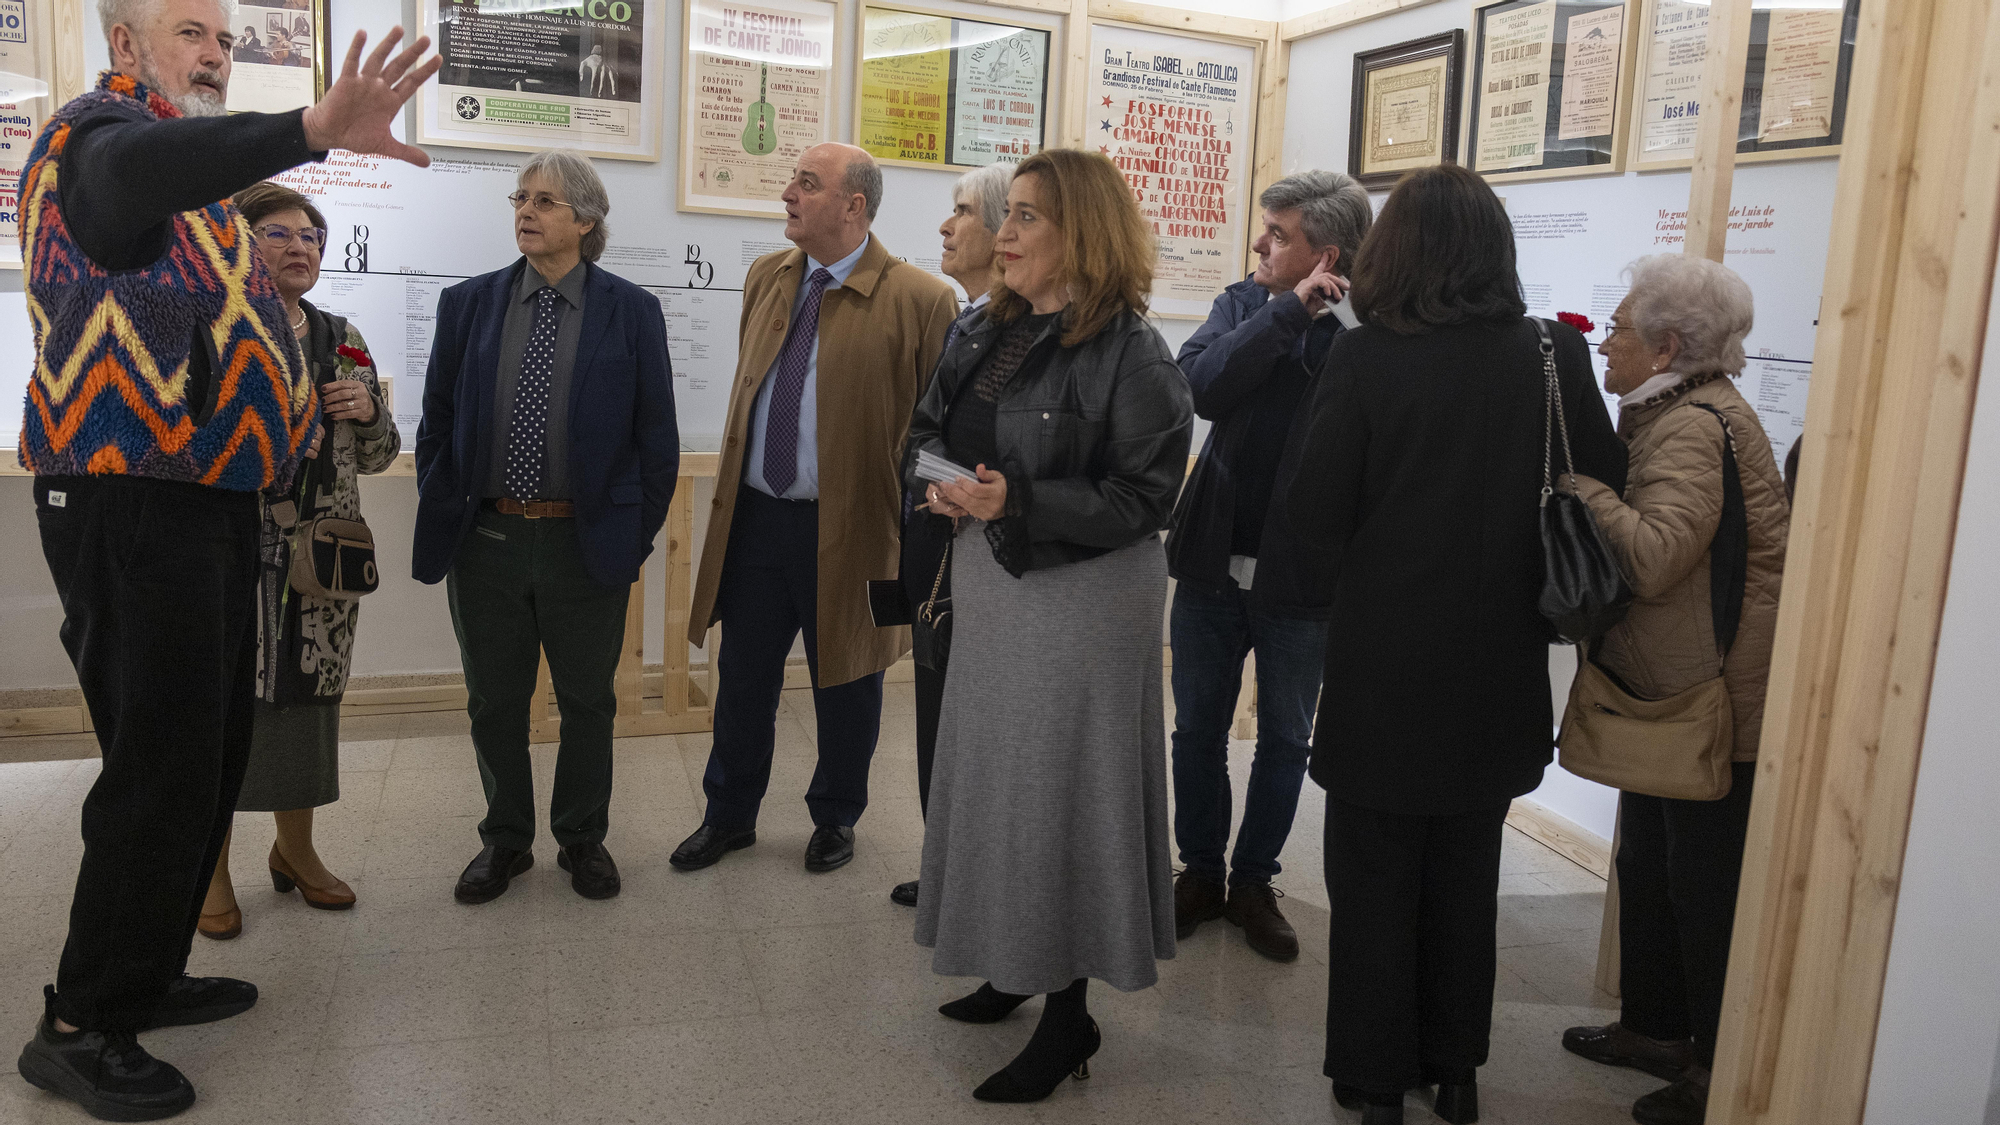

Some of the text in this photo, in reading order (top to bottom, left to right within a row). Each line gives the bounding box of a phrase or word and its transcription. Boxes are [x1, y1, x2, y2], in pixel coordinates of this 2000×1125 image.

[2, 4, 19, 12] ORA
[525, 14, 563, 25] HOMENAJE
[598, 23, 631, 32] CORDOBA
[723, 8, 805, 37] IV FESTIVAL
[1507, 19, 1529, 30] POSADAS
[704, 27, 822, 59] DE CANTE JONDO
[1573, 54, 1610, 67] SALOBREÑA
[1153, 55, 1183, 76] ISABEL
[1187, 68, 1194, 77] LA
[1196, 61, 1238, 83] CATOLICA
[702, 76, 744, 87] FOSFORITO
[770, 83, 793, 91] CARMEN
[1102, 80, 1130, 90] DOMINGO,
[1145, 86, 1164, 94] Febrero
[1103, 68, 1237, 98] Grandioso Festival de Cante Flamenco
[702, 86, 732, 95] CAMARON
[490, 99, 538, 110] COOPERATIVA
[886, 88, 941, 109] LUIS DE CORDOBA
[983, 97, 996, 111] LUIS
[998, 99, 1006, 112] DE
[1009, 100, 1035, 115] CORDOBA
[1128, 100, 1212, 123] FOSFORITO
[1662, 100, 1700, 120] José Me
[490, 109, 538, 121] FABRICACION
[540, 114, 567, 123] PROPIA
[711, 113, 743, 122] CABRERO
[908, 109, 915, 119] DE
[982, 114, 1004, 125] MANOLO
[1005, 116, 1034, 128] DOMINGUEZ
[3, 127, 32, 140] (Toto)
[1121, 114, 1217, 139] JOSE MENESE
[898, 138, 915, 149] FINO
[1113, 127, 1231, 154] CAMARON DE LA ISLA
[899, 149, 938, 161] ALVEAR
[995, 144, 1010, 154] FINO
[996, 155, 1025, 165] ALVE
[1117, 146, 1127, 155] A.
[1155, 146, 1228, 167] CHOCOLATE
[313, 157, 380, 171] elancolía y
[1112, 156, 1230, 181] GITANILLO DE VELEZ
[333, 170, 352, 178] con
[310, 176, 393, 190] la delicadeza de
[1124, 173, 1225, 196] EPE ALBAYZIN
[334, 200, 362, 208] Francisco
[361, 202, 386, 211] Hidalgo
[1149, 191, 1225, 210] DE CORDOBA
[1160, 205, 1227, 224] ARGENTINA
[1658, 204, 1775, 219] Me de Luis de
[1742, 218, 1775, 232] jarabe
[1653, 232, 1685, 245] y rigor.
[1206, 249, 1222, 257] Valle
